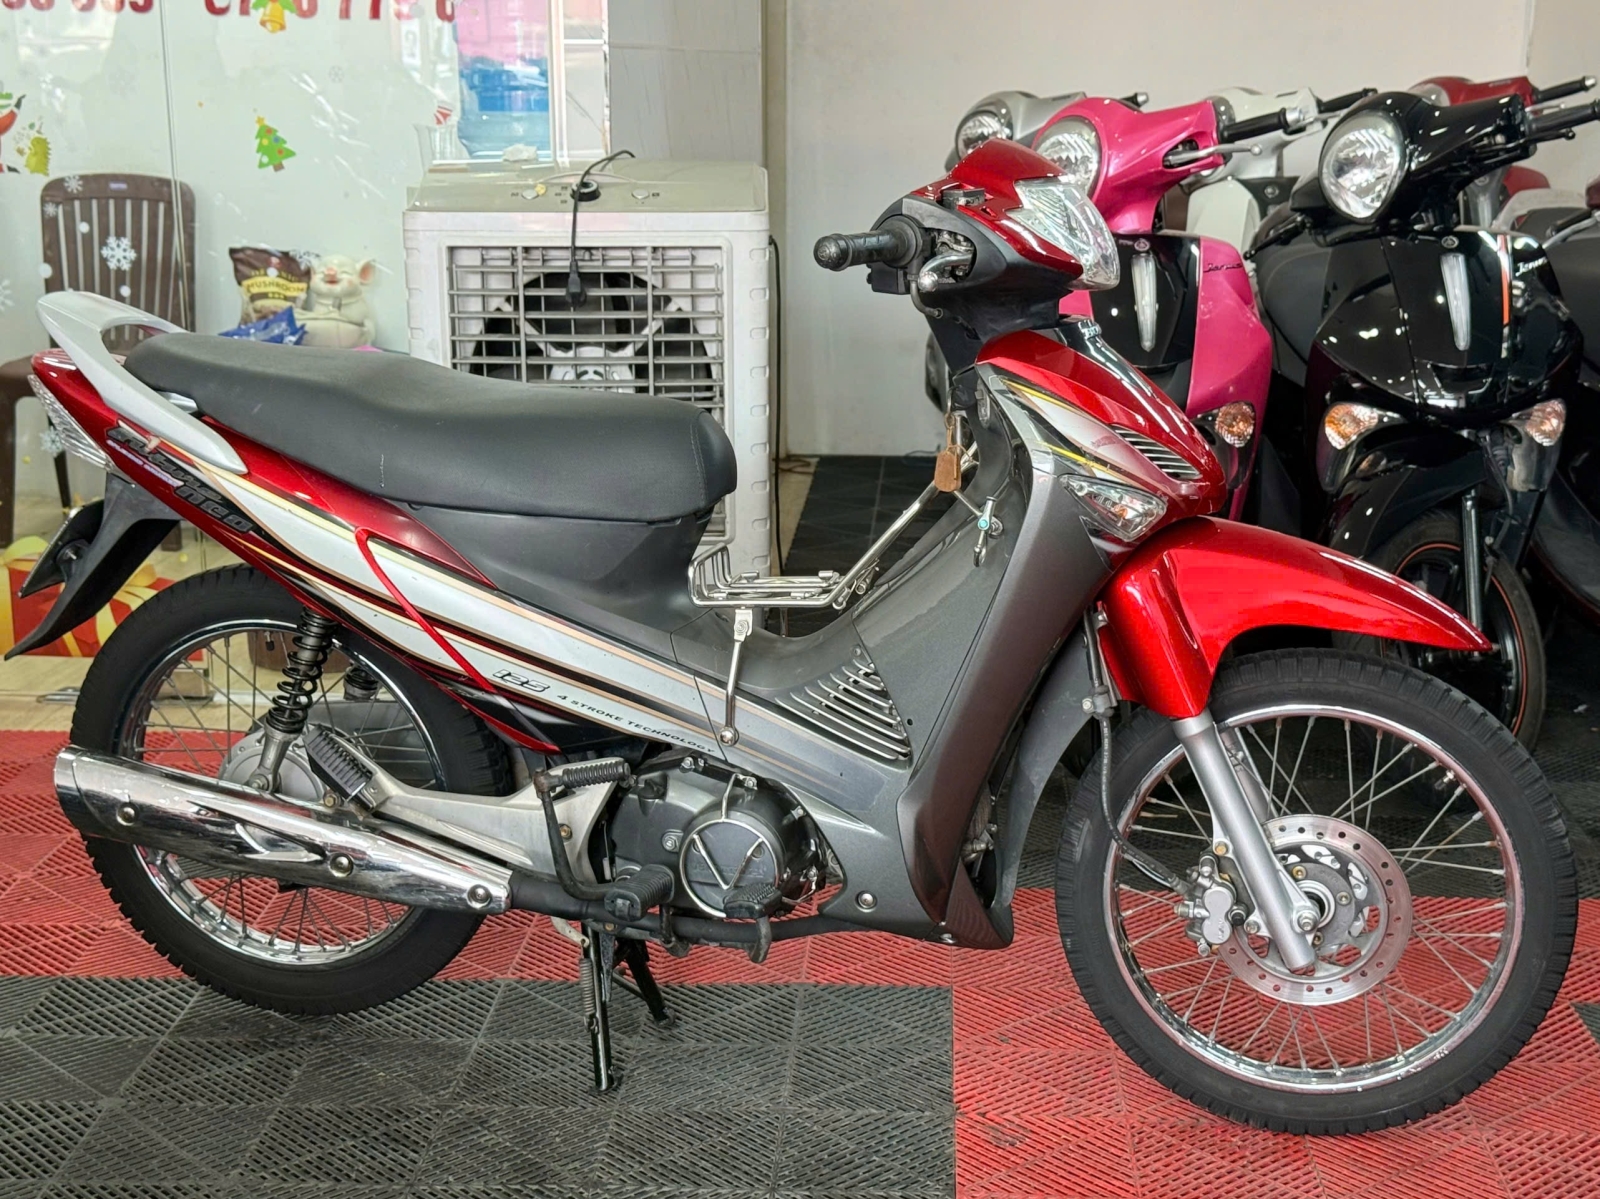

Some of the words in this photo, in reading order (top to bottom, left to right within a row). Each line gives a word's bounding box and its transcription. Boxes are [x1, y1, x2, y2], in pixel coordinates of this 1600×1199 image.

[492, 668, 551, 693] 125
[570, 699, 624, 722] STROKE
[626, 720, 715, 753] TECHNOLOGY
